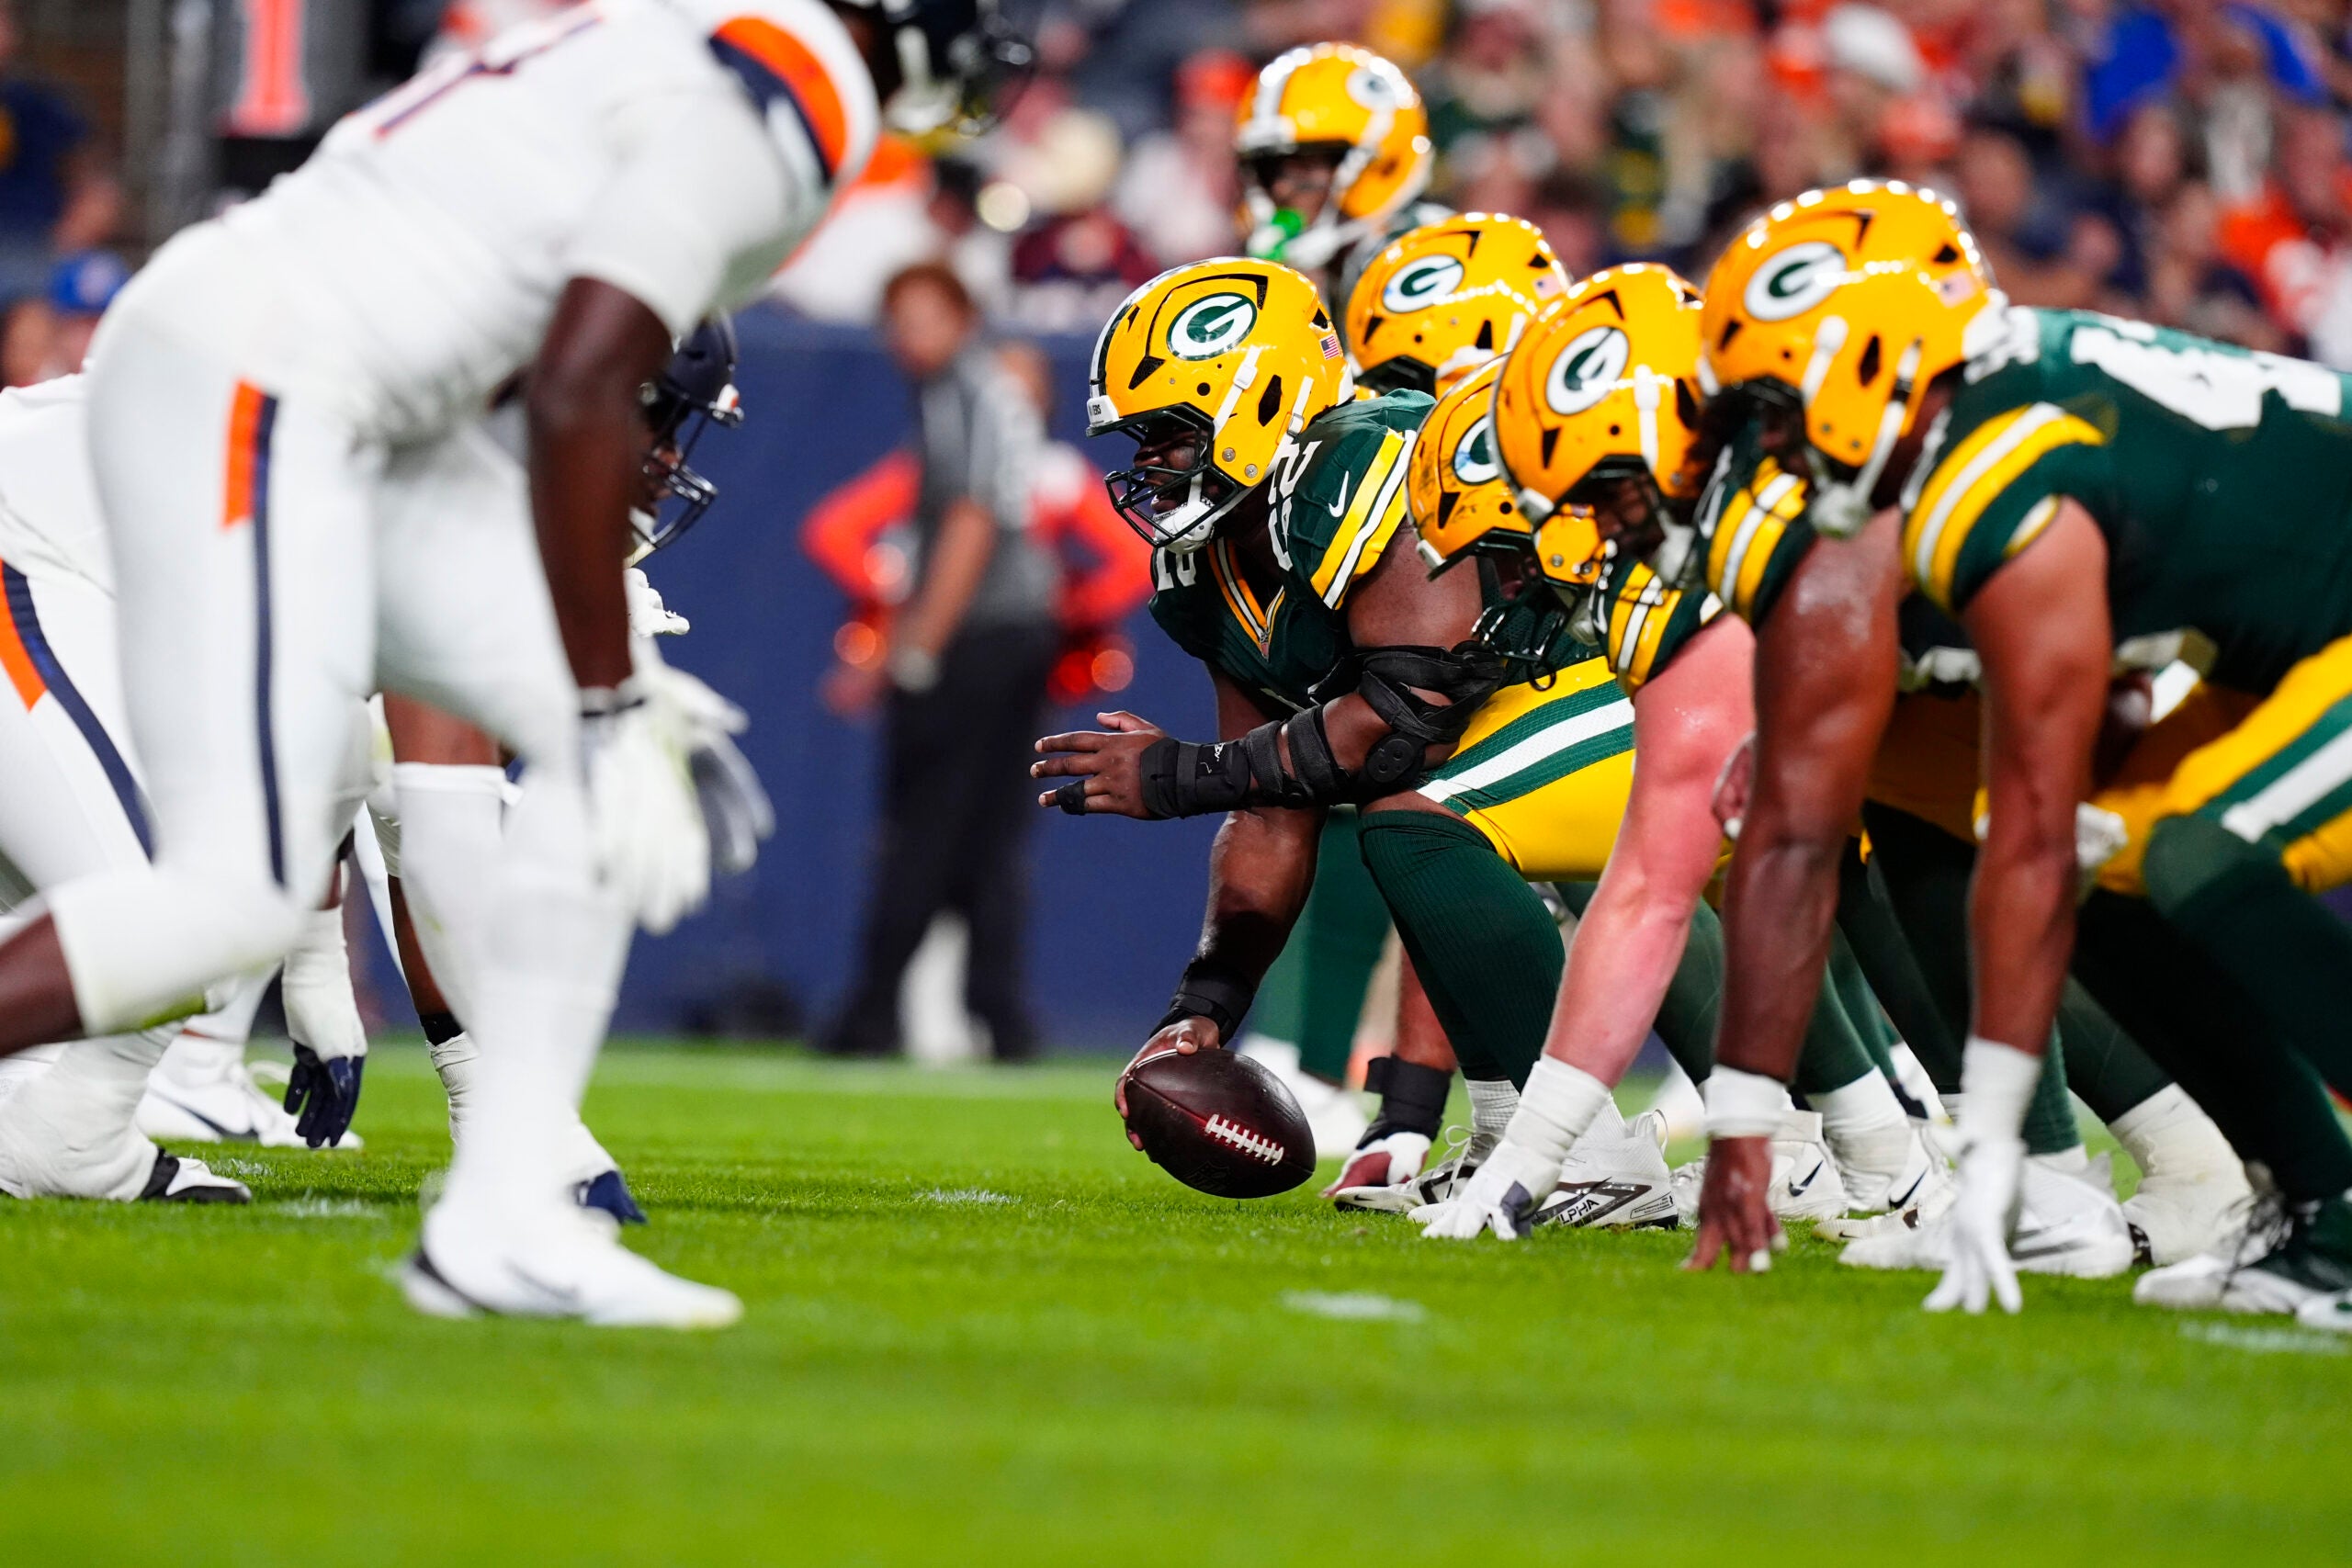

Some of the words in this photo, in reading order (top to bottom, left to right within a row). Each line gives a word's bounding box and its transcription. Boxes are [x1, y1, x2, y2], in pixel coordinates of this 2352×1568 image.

[1383, 254, 1464, 313] G
[1744, 241, 1847, 321] G
[1169, 294, 1254, 358] G
[1546, 326, 1629, 415] G
[1557, 1198, 1600, 1224] LPHA
